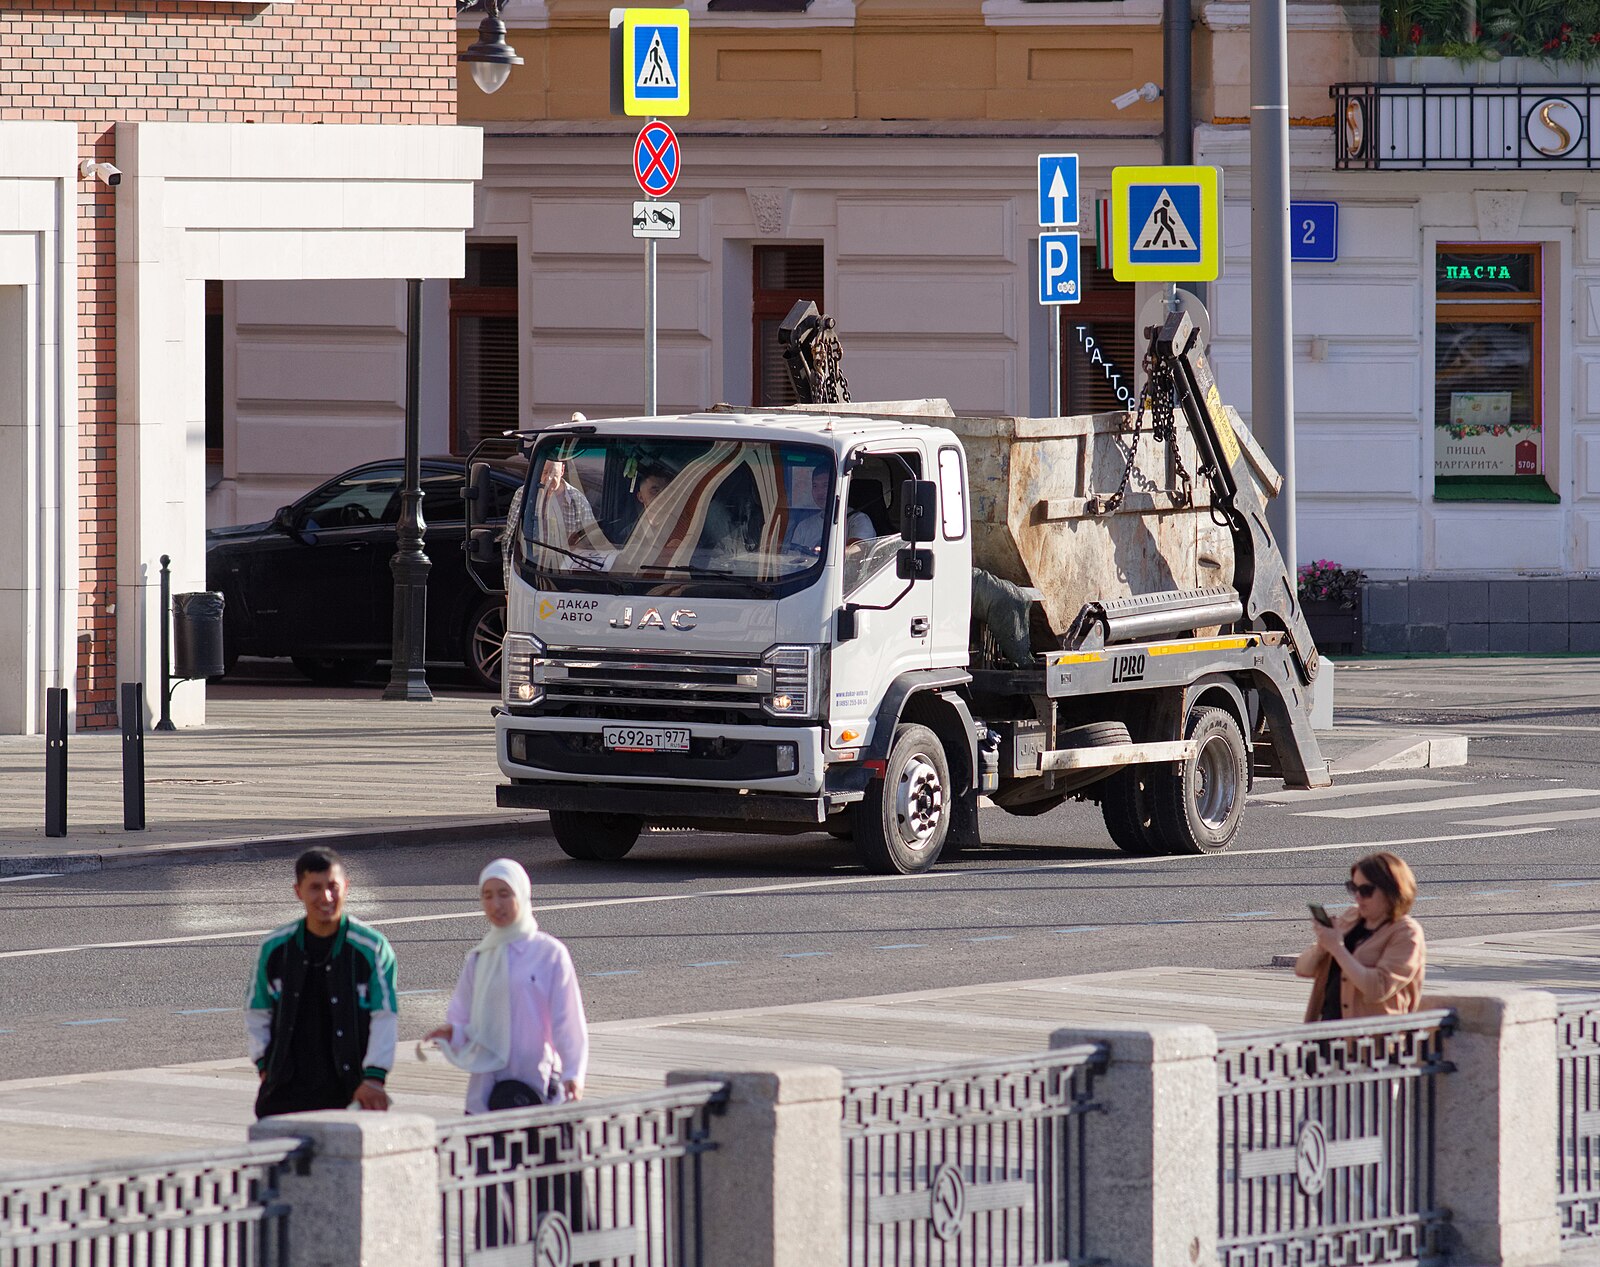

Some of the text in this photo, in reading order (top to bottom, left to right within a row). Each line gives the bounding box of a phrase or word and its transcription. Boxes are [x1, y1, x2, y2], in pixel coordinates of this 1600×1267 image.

[1539, 102, 1571, 153] S
[1302, 219, 1315, 244] 2
[1046, 241, 1068, 296] P
[1446, 266, 1511, 279] ПАСТА
[1446, 446, 1486, 455] ПИЦЦА
[556, 599, 599, 610] ДАКАР
[560, 612, 593, 622] АВТО
[609, 607, 698, 632] JAC
[608, 730, 686, 747] С692ВТ 977
